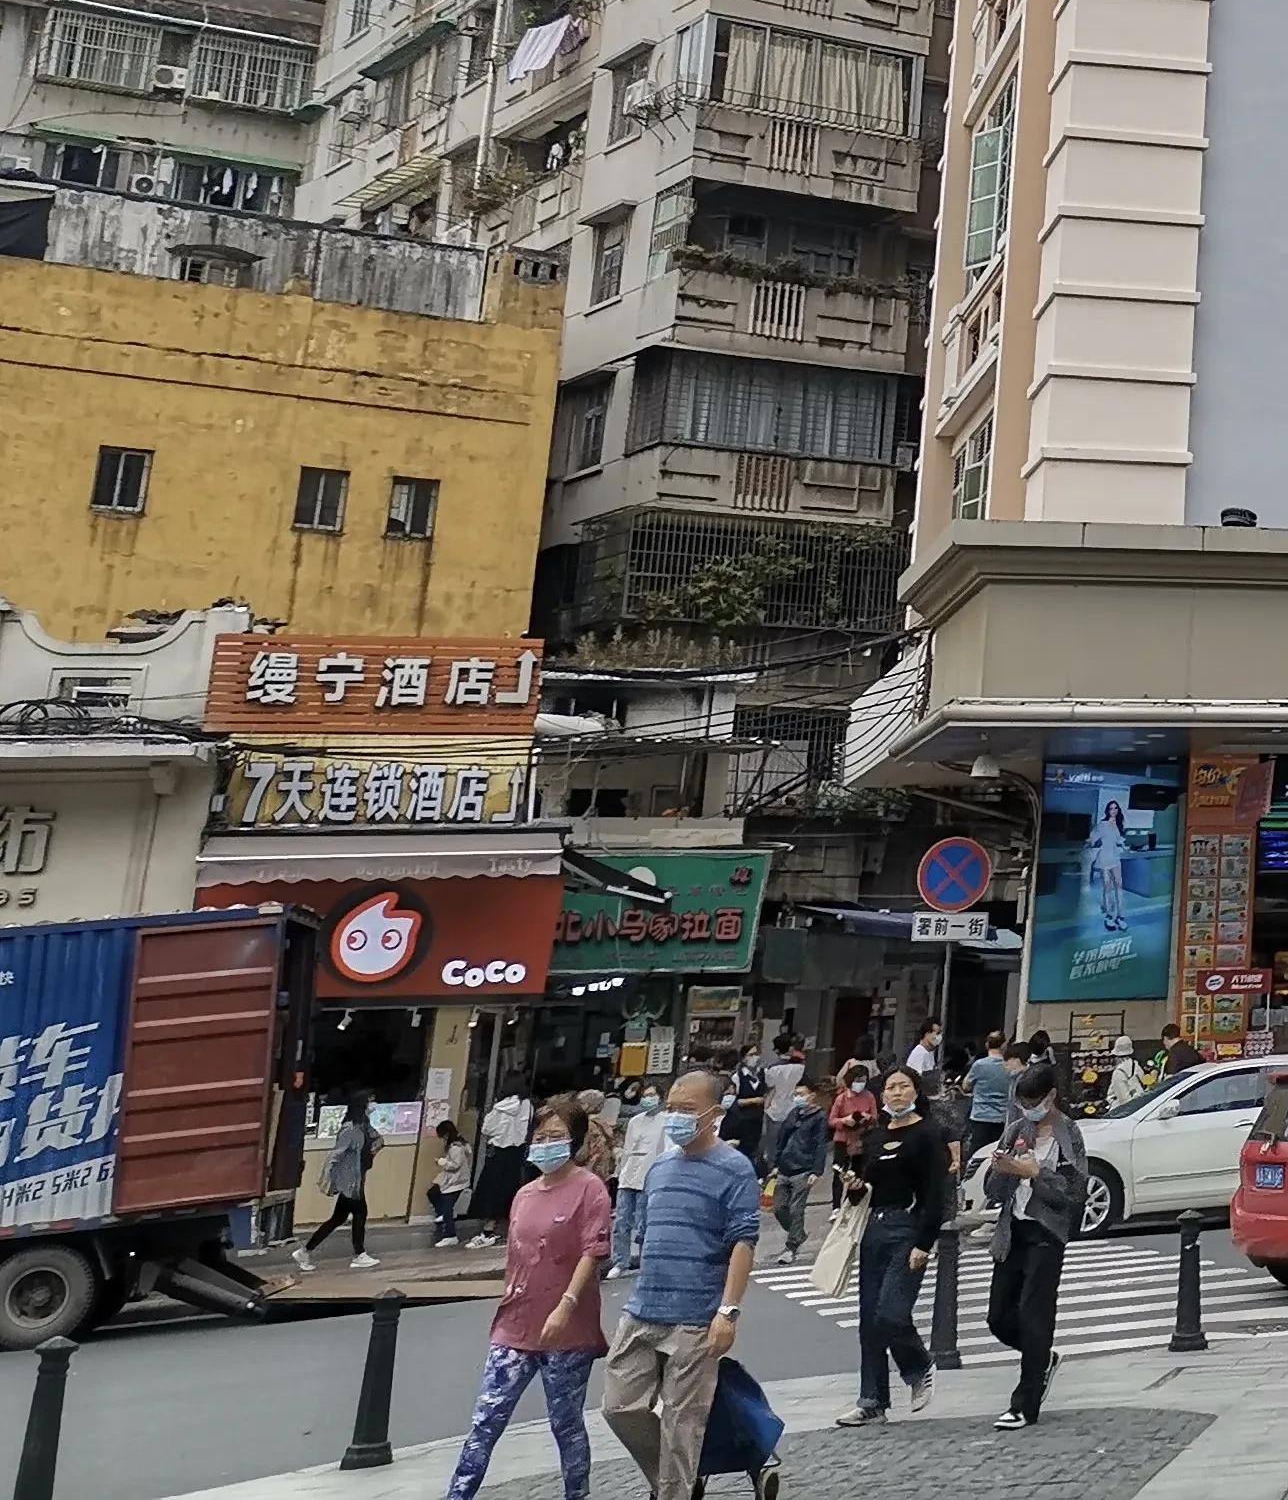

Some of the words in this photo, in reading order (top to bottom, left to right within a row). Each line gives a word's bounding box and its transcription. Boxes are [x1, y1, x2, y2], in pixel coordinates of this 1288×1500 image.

[246, 651, 496, 708] 缦宁酒店
[241, 762, 490, 824] 7天连锁酒店
[917, 917, 985, 937] 署前一街
[441, 959, 527, 988] CoCo
[51, 1166, 92, 1196] 5米2
